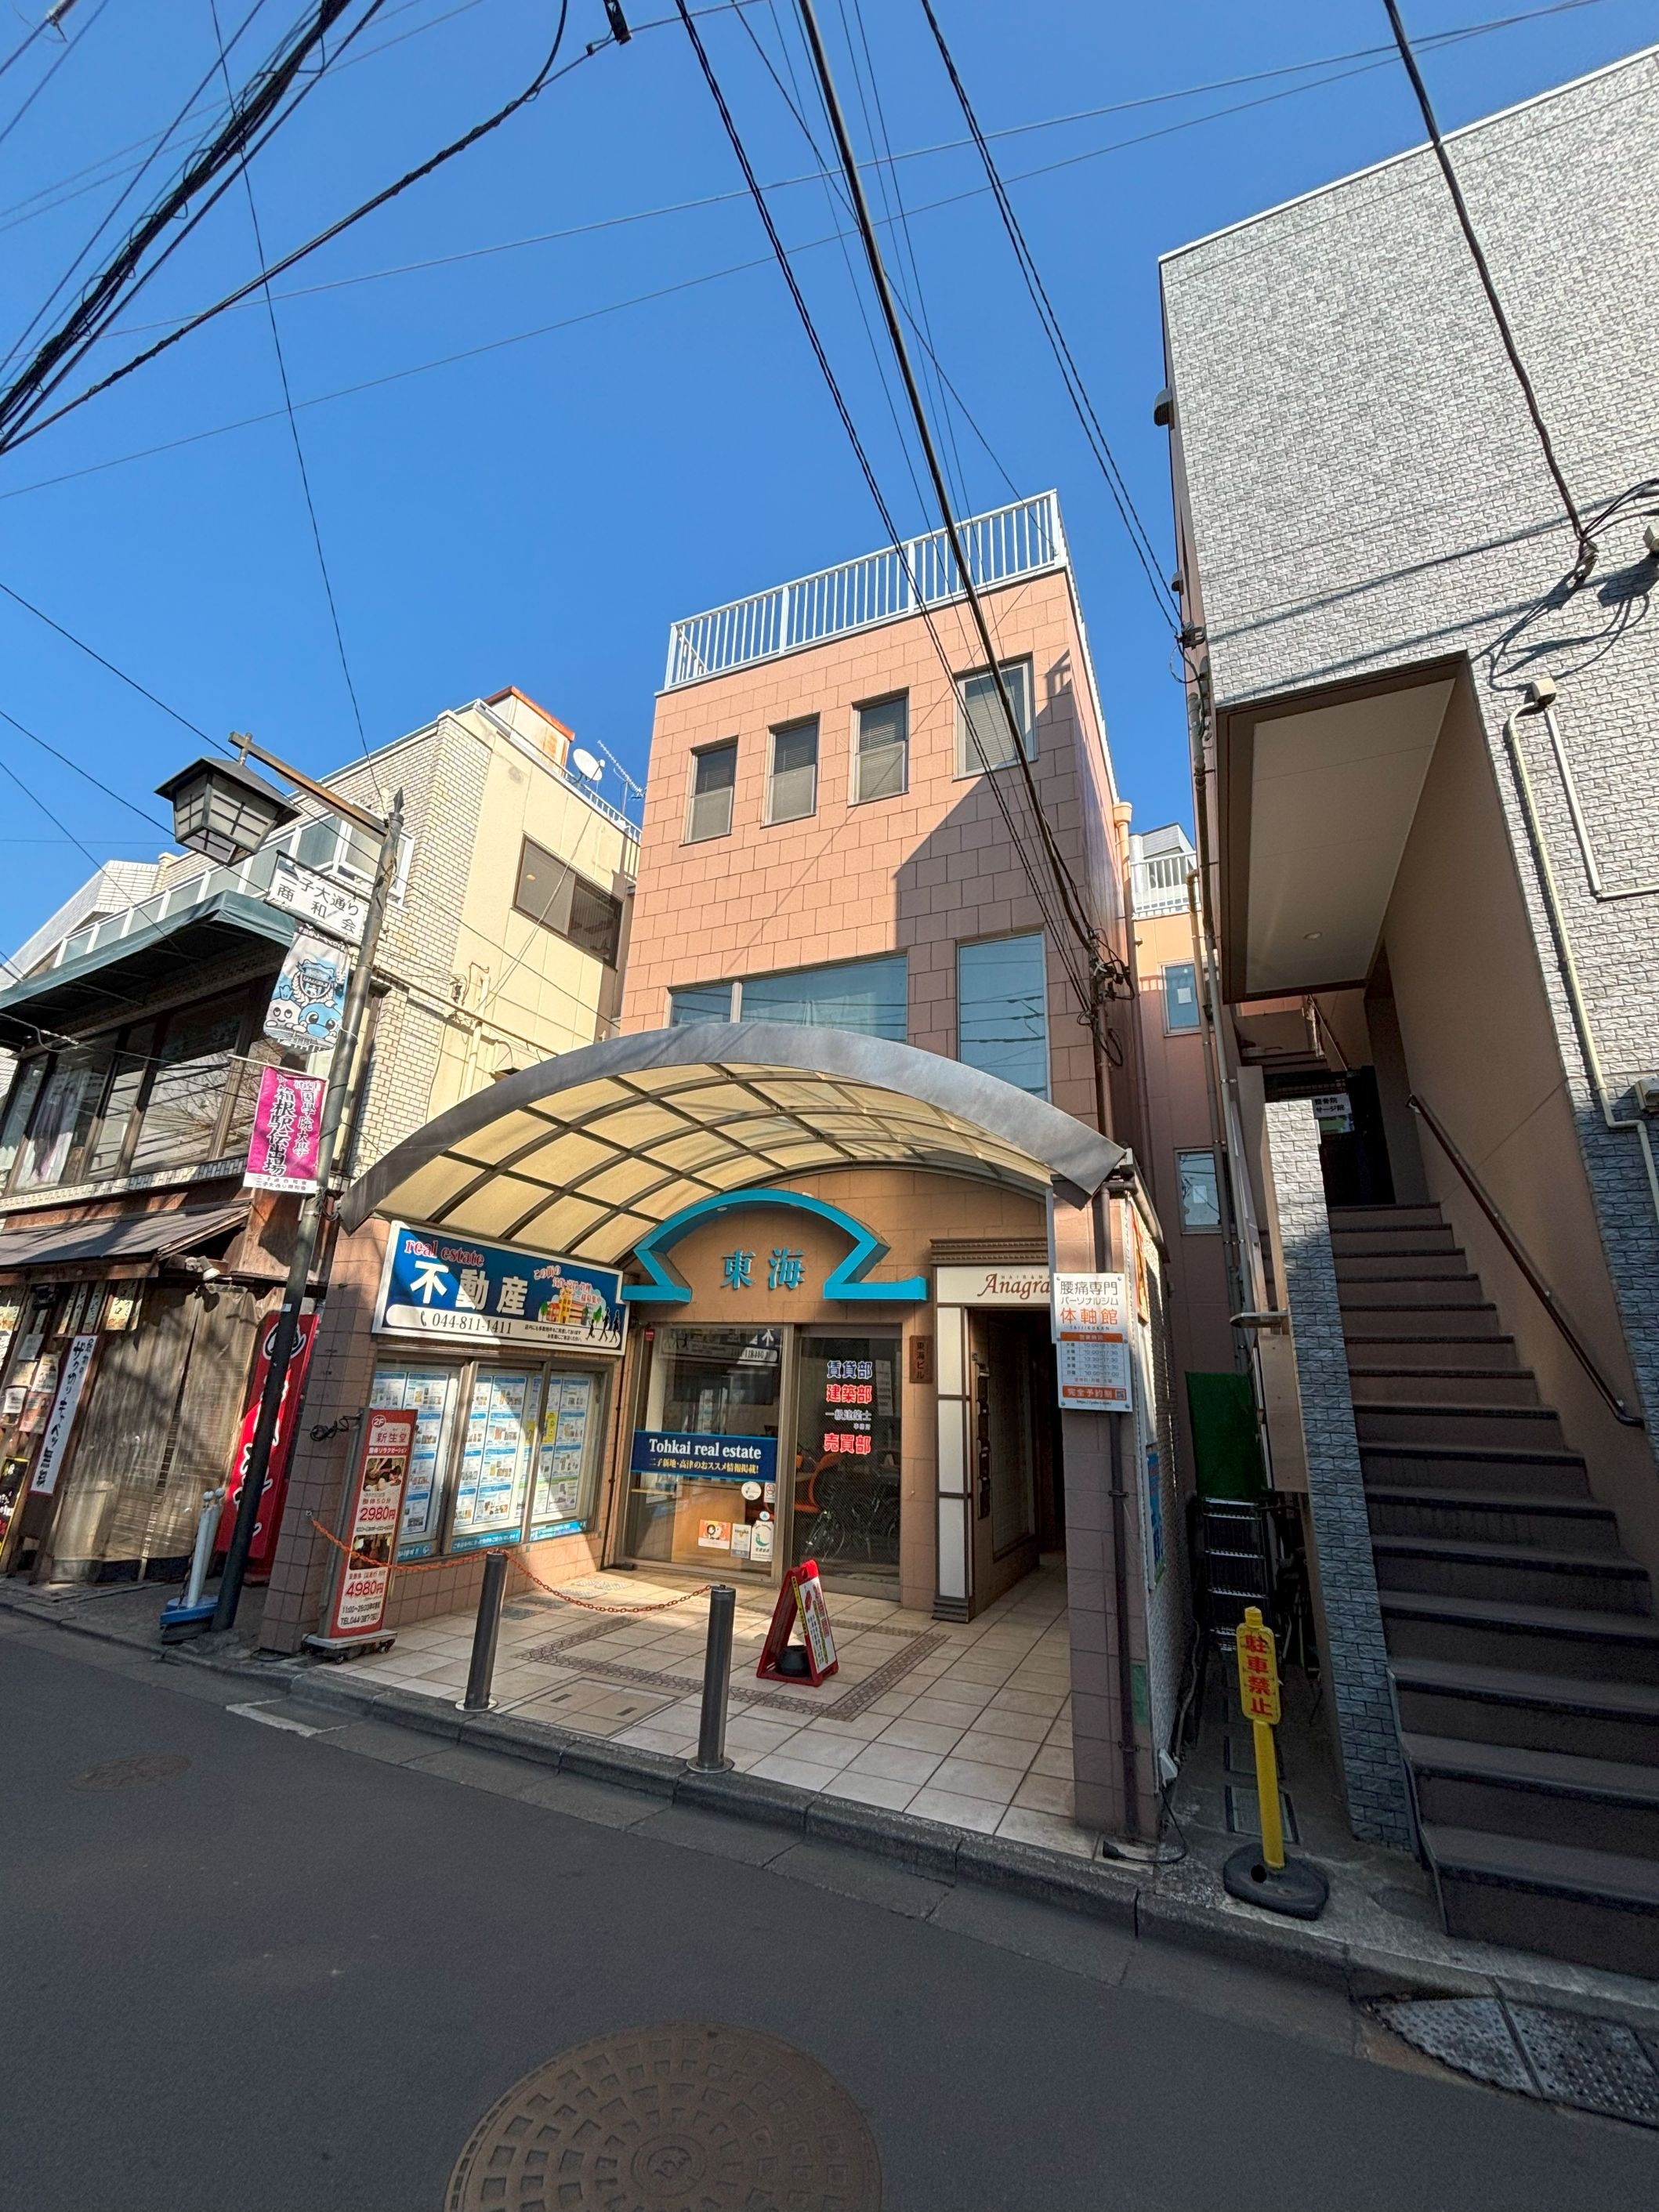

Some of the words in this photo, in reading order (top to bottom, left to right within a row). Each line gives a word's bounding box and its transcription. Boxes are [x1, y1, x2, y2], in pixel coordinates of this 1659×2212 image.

[281, 876, 359, 916] 二子大通り
[277, 884, 357, 935] 商和会
[404, 1240, 438, 1258] real
[441, 1247, 485, 1266] estate
[719, 1247, 806, 1289] 東海
[410, 1260, 528, 1316] 不動産
[1060, 1281, 1117, 1295] 腰痛専門
[1061, 1296, 1119, 1305] パーソナルジム
[432, 1312, 512, 1334] 044-811-1411
[1060, 1308, 1117, 1325] 体軸館
[827, 1360, 872, 1379] 賃貸部
[916, 1341, 925, 1380] 東海ビル
[826, 1384, 871, 1403] 建築部
[1067, 1388, 1112, 1399] 完全予約制
[374, 1417, 385, 1426] 2F
[825, 1409, 871, 1421] 一級建築士
[376, 1432, 407, 1443] 新生堂
[824, 1433, 871, 1455] 売買部
[649, 1438, 690, 1454] Tohkai
[694, 1443, 719, 1457] real
[723, 1446, 762, 1460] estate
[360, 1506, 397, 1521] 2980円
[346, 1580, 384, 1597] 4980円
[1244, 1635, 1273, 1717] 駐車禁止
